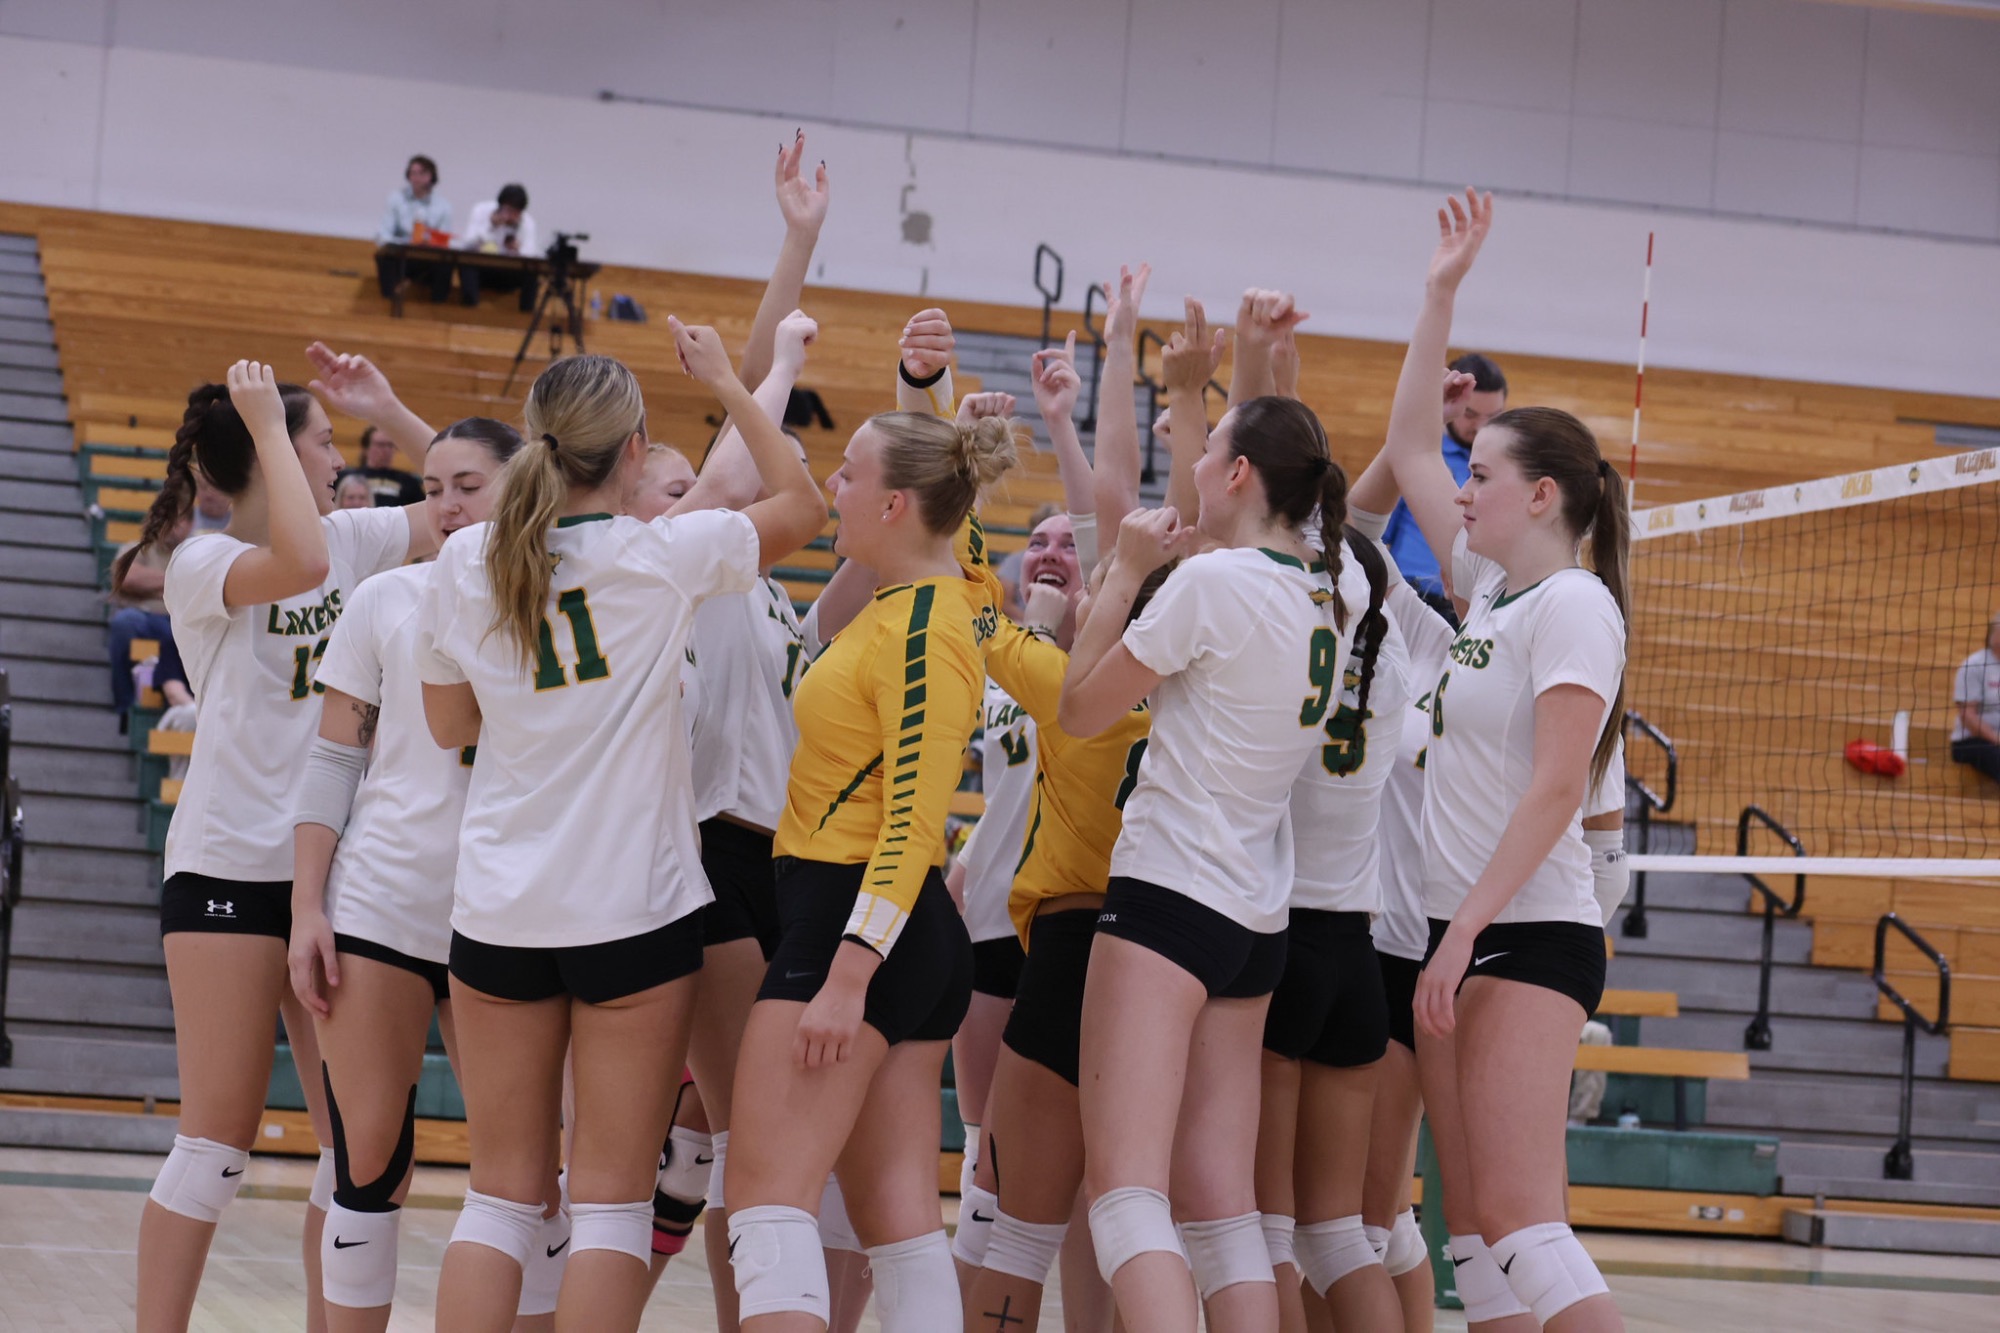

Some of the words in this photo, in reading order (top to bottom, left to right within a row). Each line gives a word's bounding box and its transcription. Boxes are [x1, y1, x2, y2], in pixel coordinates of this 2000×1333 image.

[267, 588, 343, 636] LAKERS
[532, 585, 612, 693] 11
[1299, 626, 1337, 729] 9
[1432, 669, 1451, 739] 6
